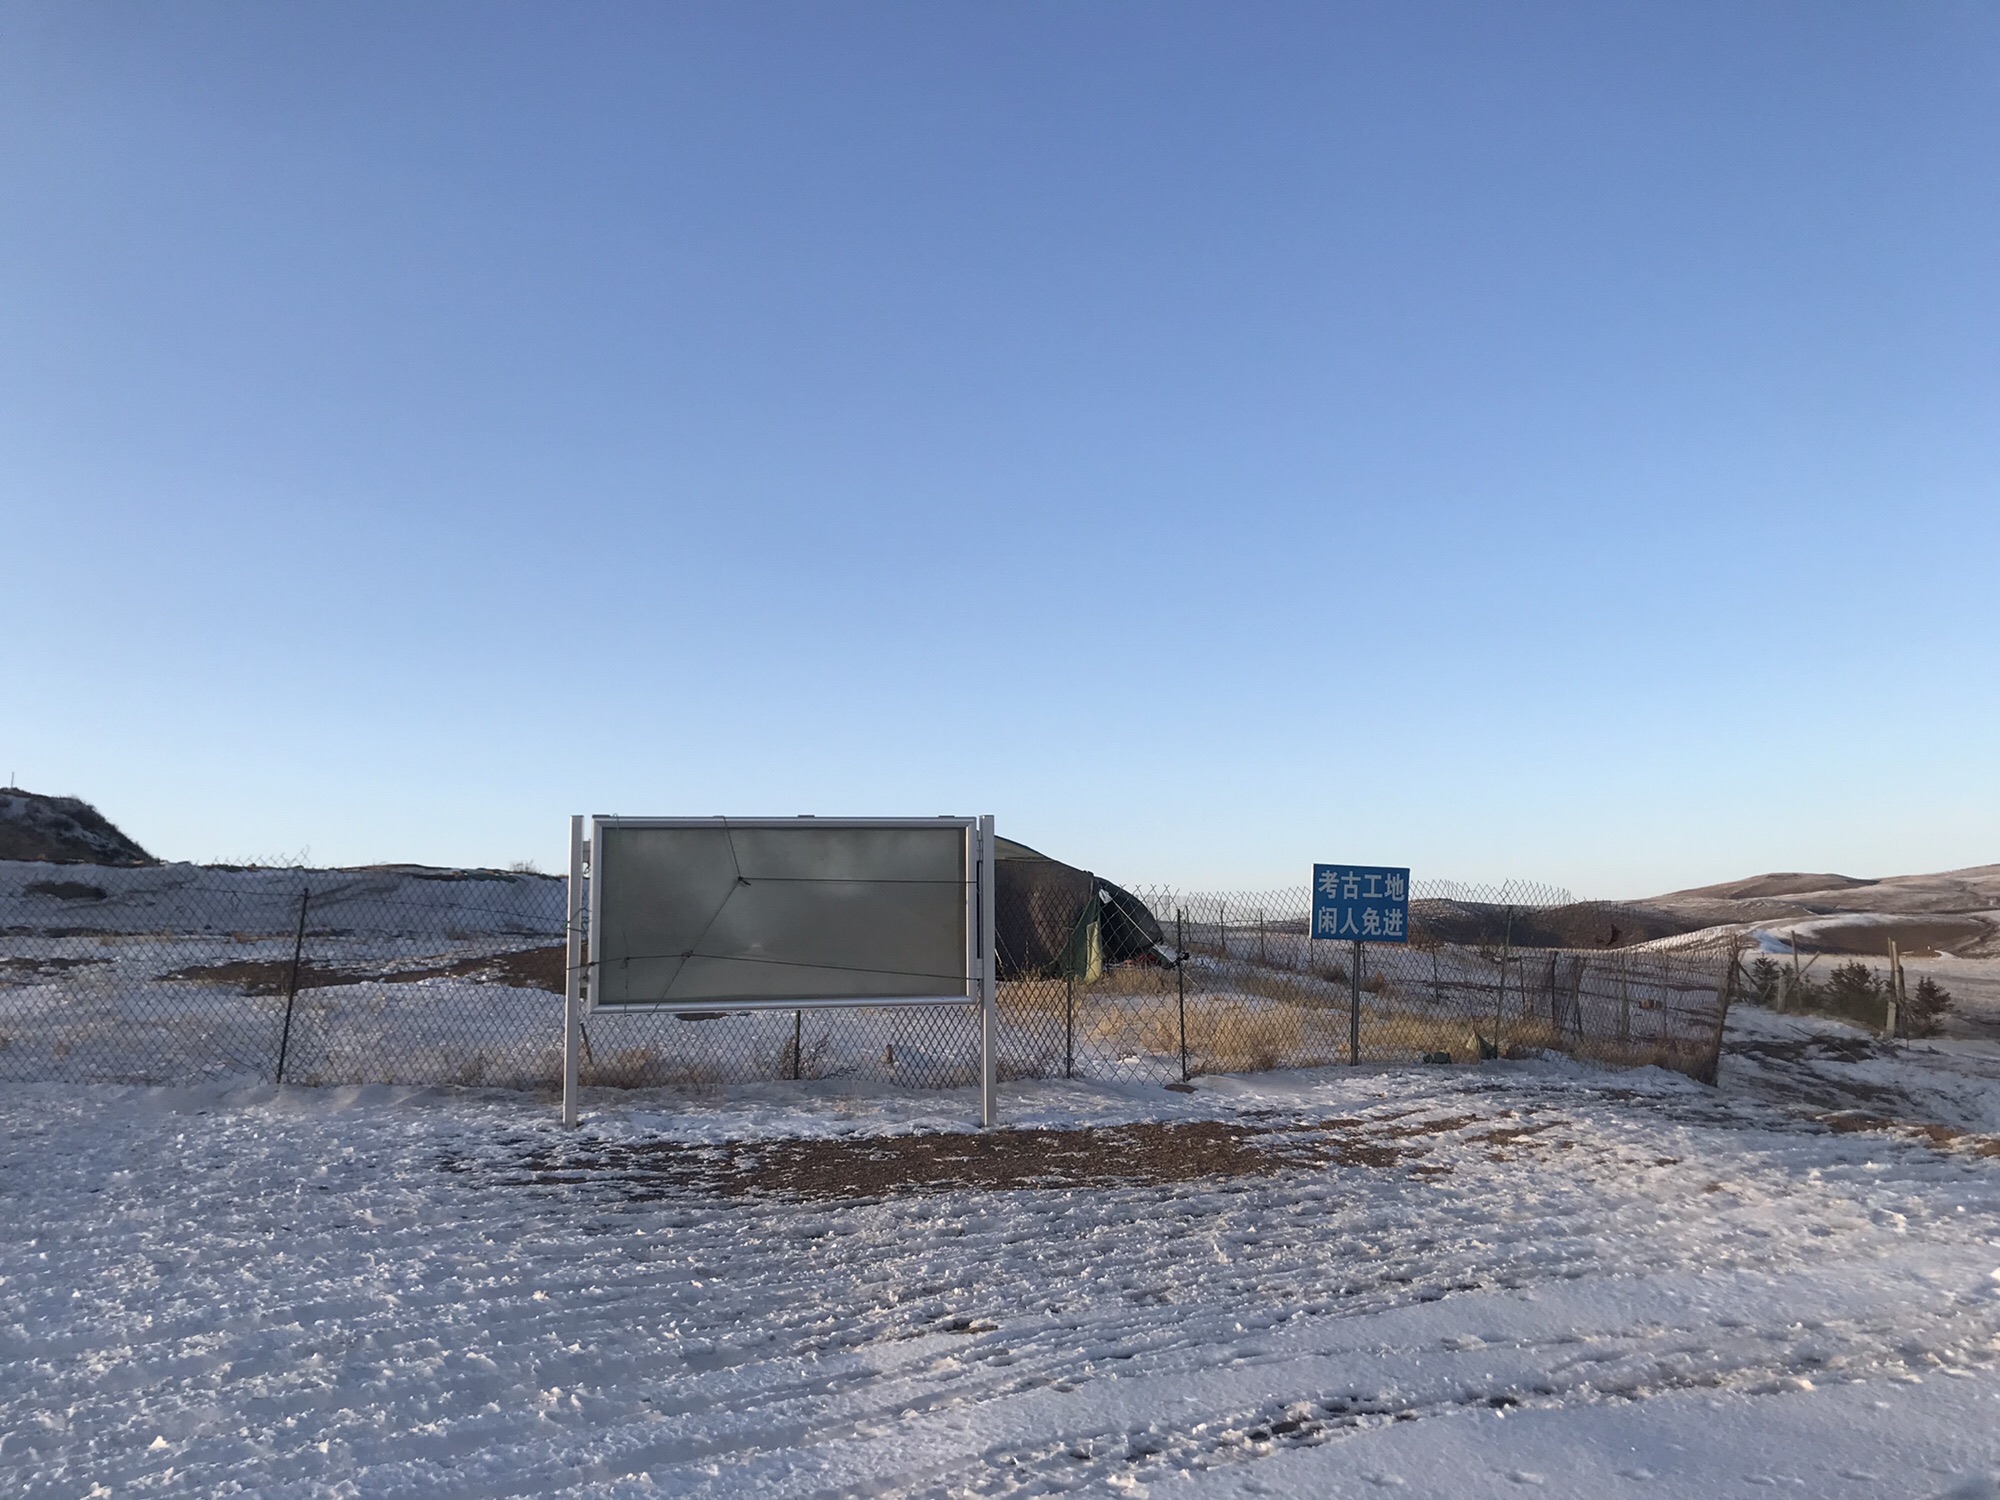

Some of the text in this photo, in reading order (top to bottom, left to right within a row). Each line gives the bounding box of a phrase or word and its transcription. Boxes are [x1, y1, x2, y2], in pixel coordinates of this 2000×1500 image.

[1318, 870, 1405, 902] 考古工地
[1317, 906, 1403, 937] 闲人免进
